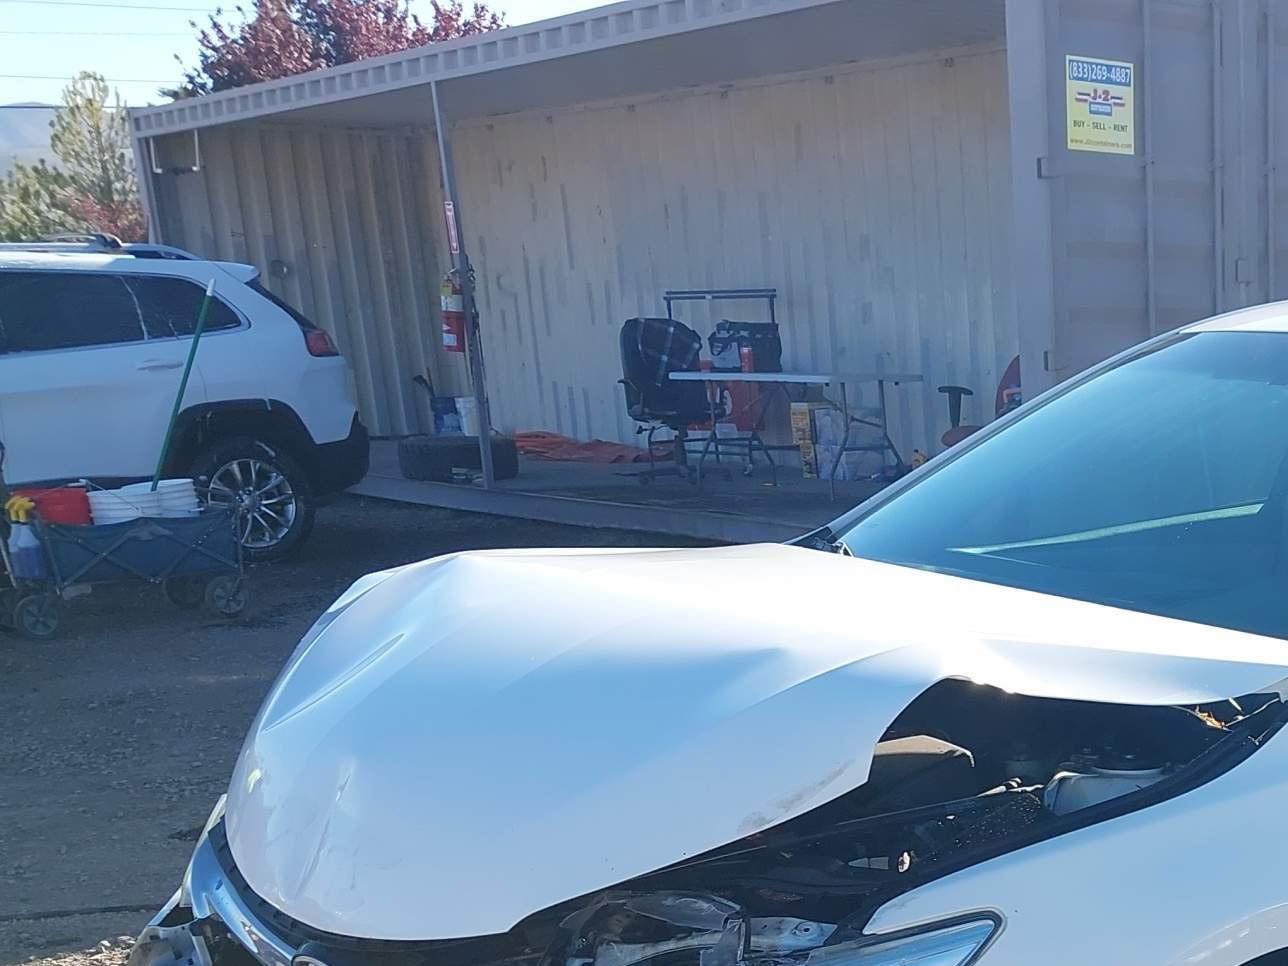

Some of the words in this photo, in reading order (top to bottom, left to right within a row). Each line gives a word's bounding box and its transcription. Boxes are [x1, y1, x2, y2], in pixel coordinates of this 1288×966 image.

[1069, 61, 1131, 84] (833)269-4887
[1073, 119, 1085, 128] BUY
[1092, 121, 1106, 131] SELL
[1113, 123, 1128, 133] RENT
